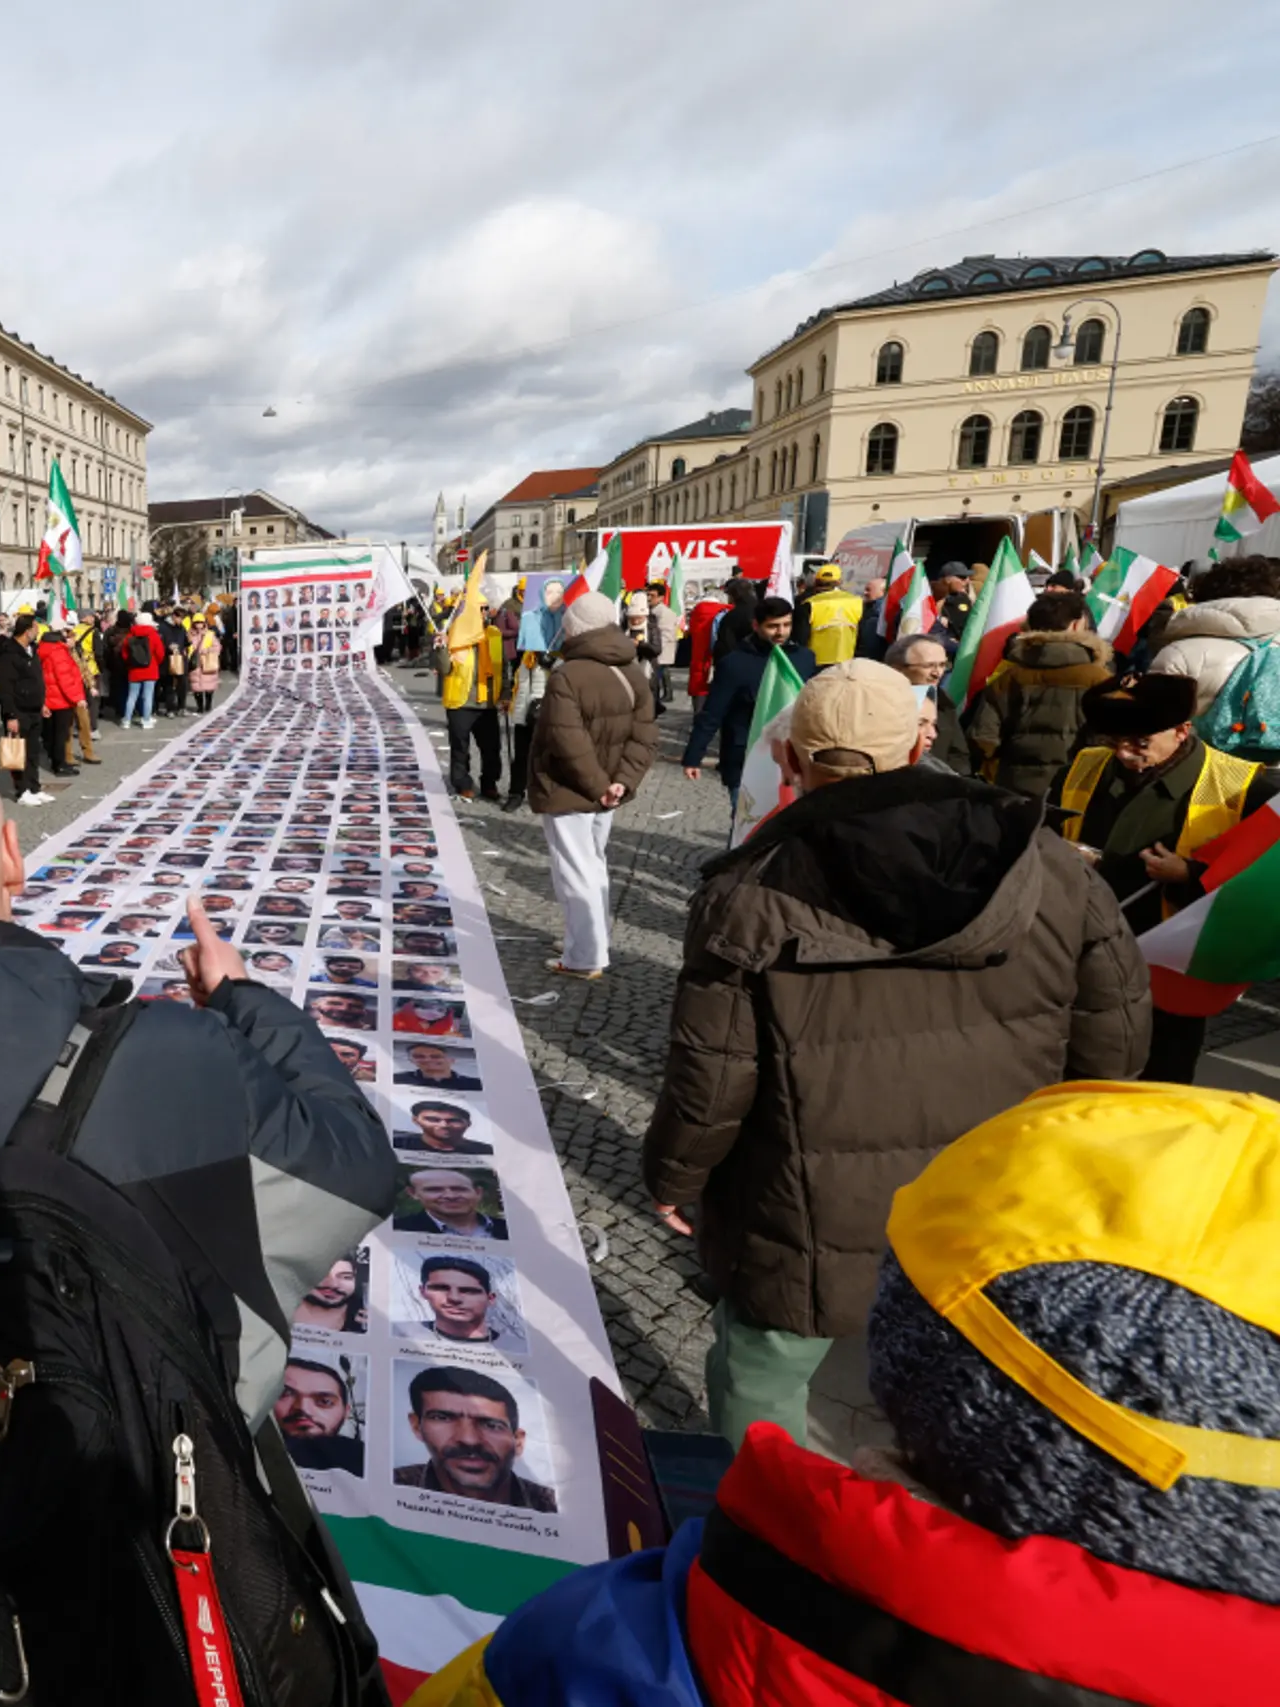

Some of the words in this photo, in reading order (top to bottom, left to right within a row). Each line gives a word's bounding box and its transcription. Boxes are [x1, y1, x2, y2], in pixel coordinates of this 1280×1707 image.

[963, 375, 1042, 393] ANNAST
[1053, 367, 1109, 386] HAUS
[646, 539, 728, 563] AVIS
